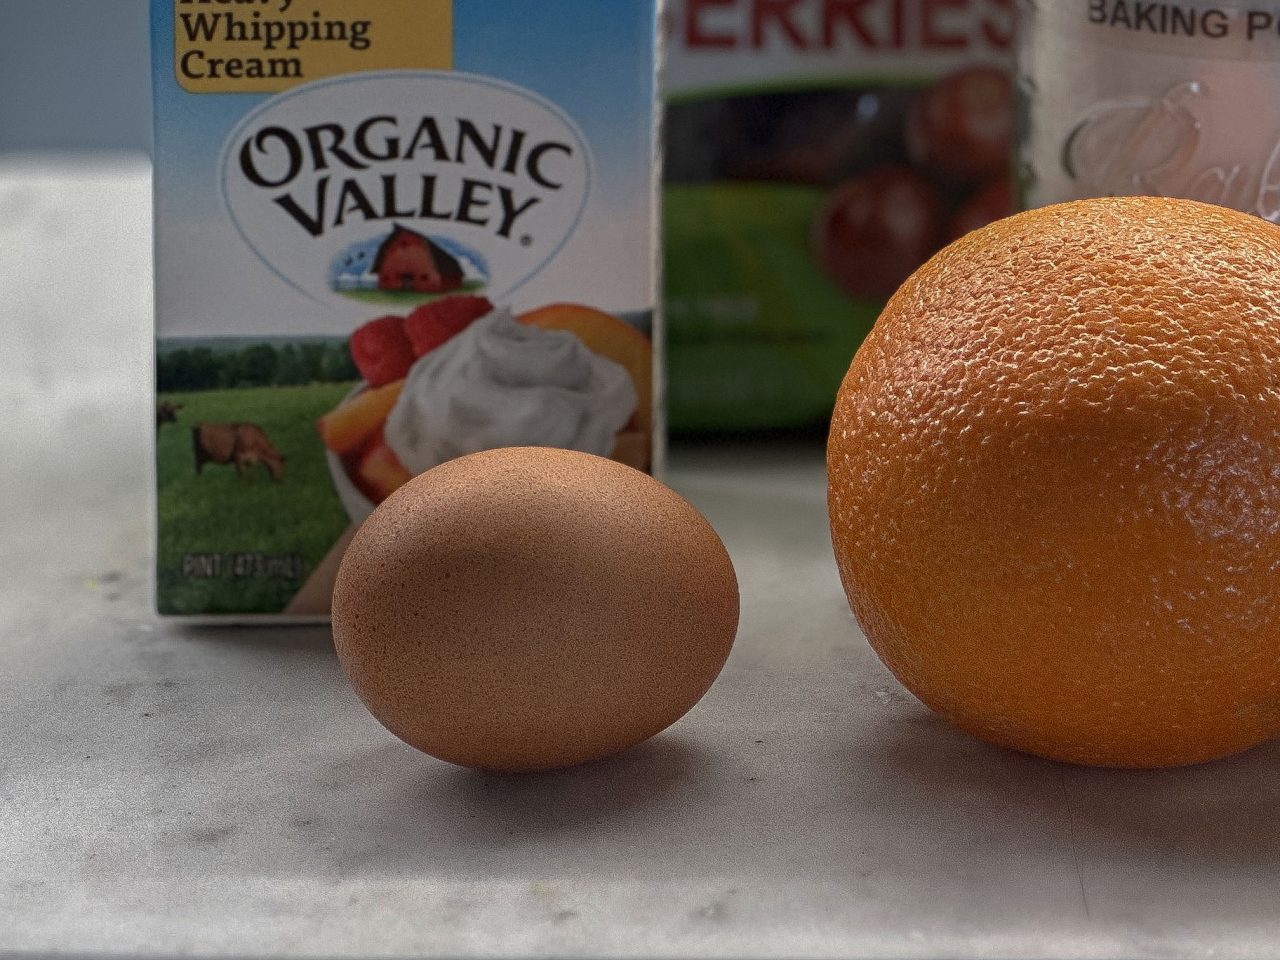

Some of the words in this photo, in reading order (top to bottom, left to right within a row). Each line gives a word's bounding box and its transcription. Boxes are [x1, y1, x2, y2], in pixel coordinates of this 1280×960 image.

[179, 12, 372, 50] Whipping
[180, 50, 303, 79] Cream
[238, 115, 573, 190] ORGANIC
[273, 174, 541, 240] VALLEY
